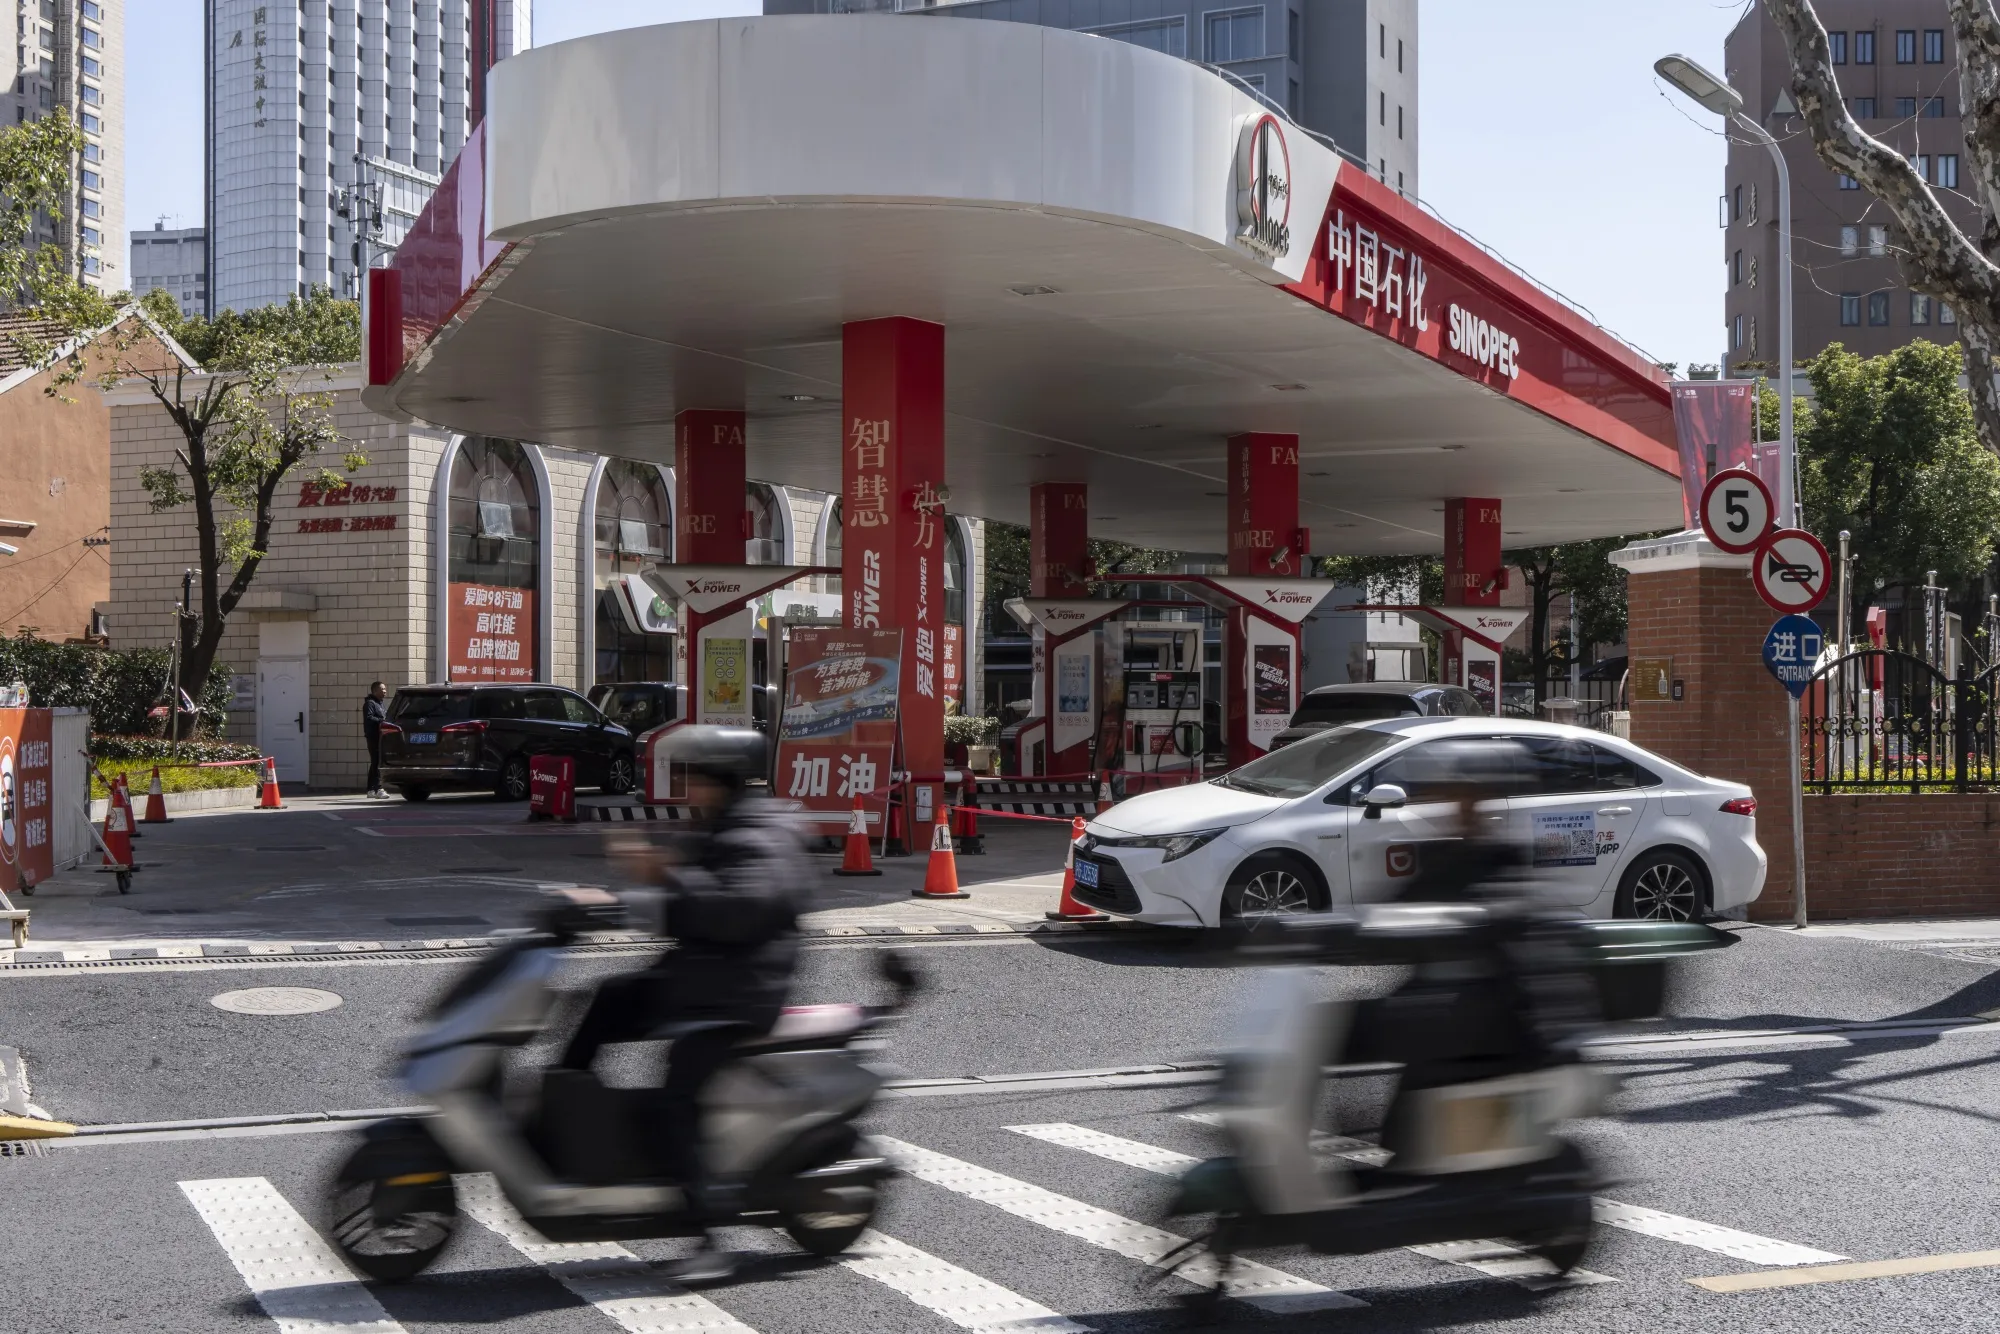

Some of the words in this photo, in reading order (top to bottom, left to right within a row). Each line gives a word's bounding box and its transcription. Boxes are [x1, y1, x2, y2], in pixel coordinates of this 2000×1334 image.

[1329, 208, 1428, 332] 中国石化
[1449, 303, 1520, 380] SINOPEC
[713, 424, 746, 445] FA
[849, 418, 890, 527] 智慧
[1725, 489, 1750, 534] 5
[464, 587, 523, 609] 爱跑98汽油
[853, 590, 862, 628] OPEC
[476, 613, 517, 635] 高性能
[467, 637, 521, 661] 品牌燃油
[826, 642, 845, 651] 爱跑
[1772, 632, 1821, 662] 进口
[815, 657, 866, 679] 为爱奔跑
[916, 630, 935, 699] 爱跑
[818, 671, 871, 693] 洁净所能
[20, 740, 49, 770] 加油站进口
[789, 752, 877, 798] 加油
[23, 779, 47, 809] 禁止停车
